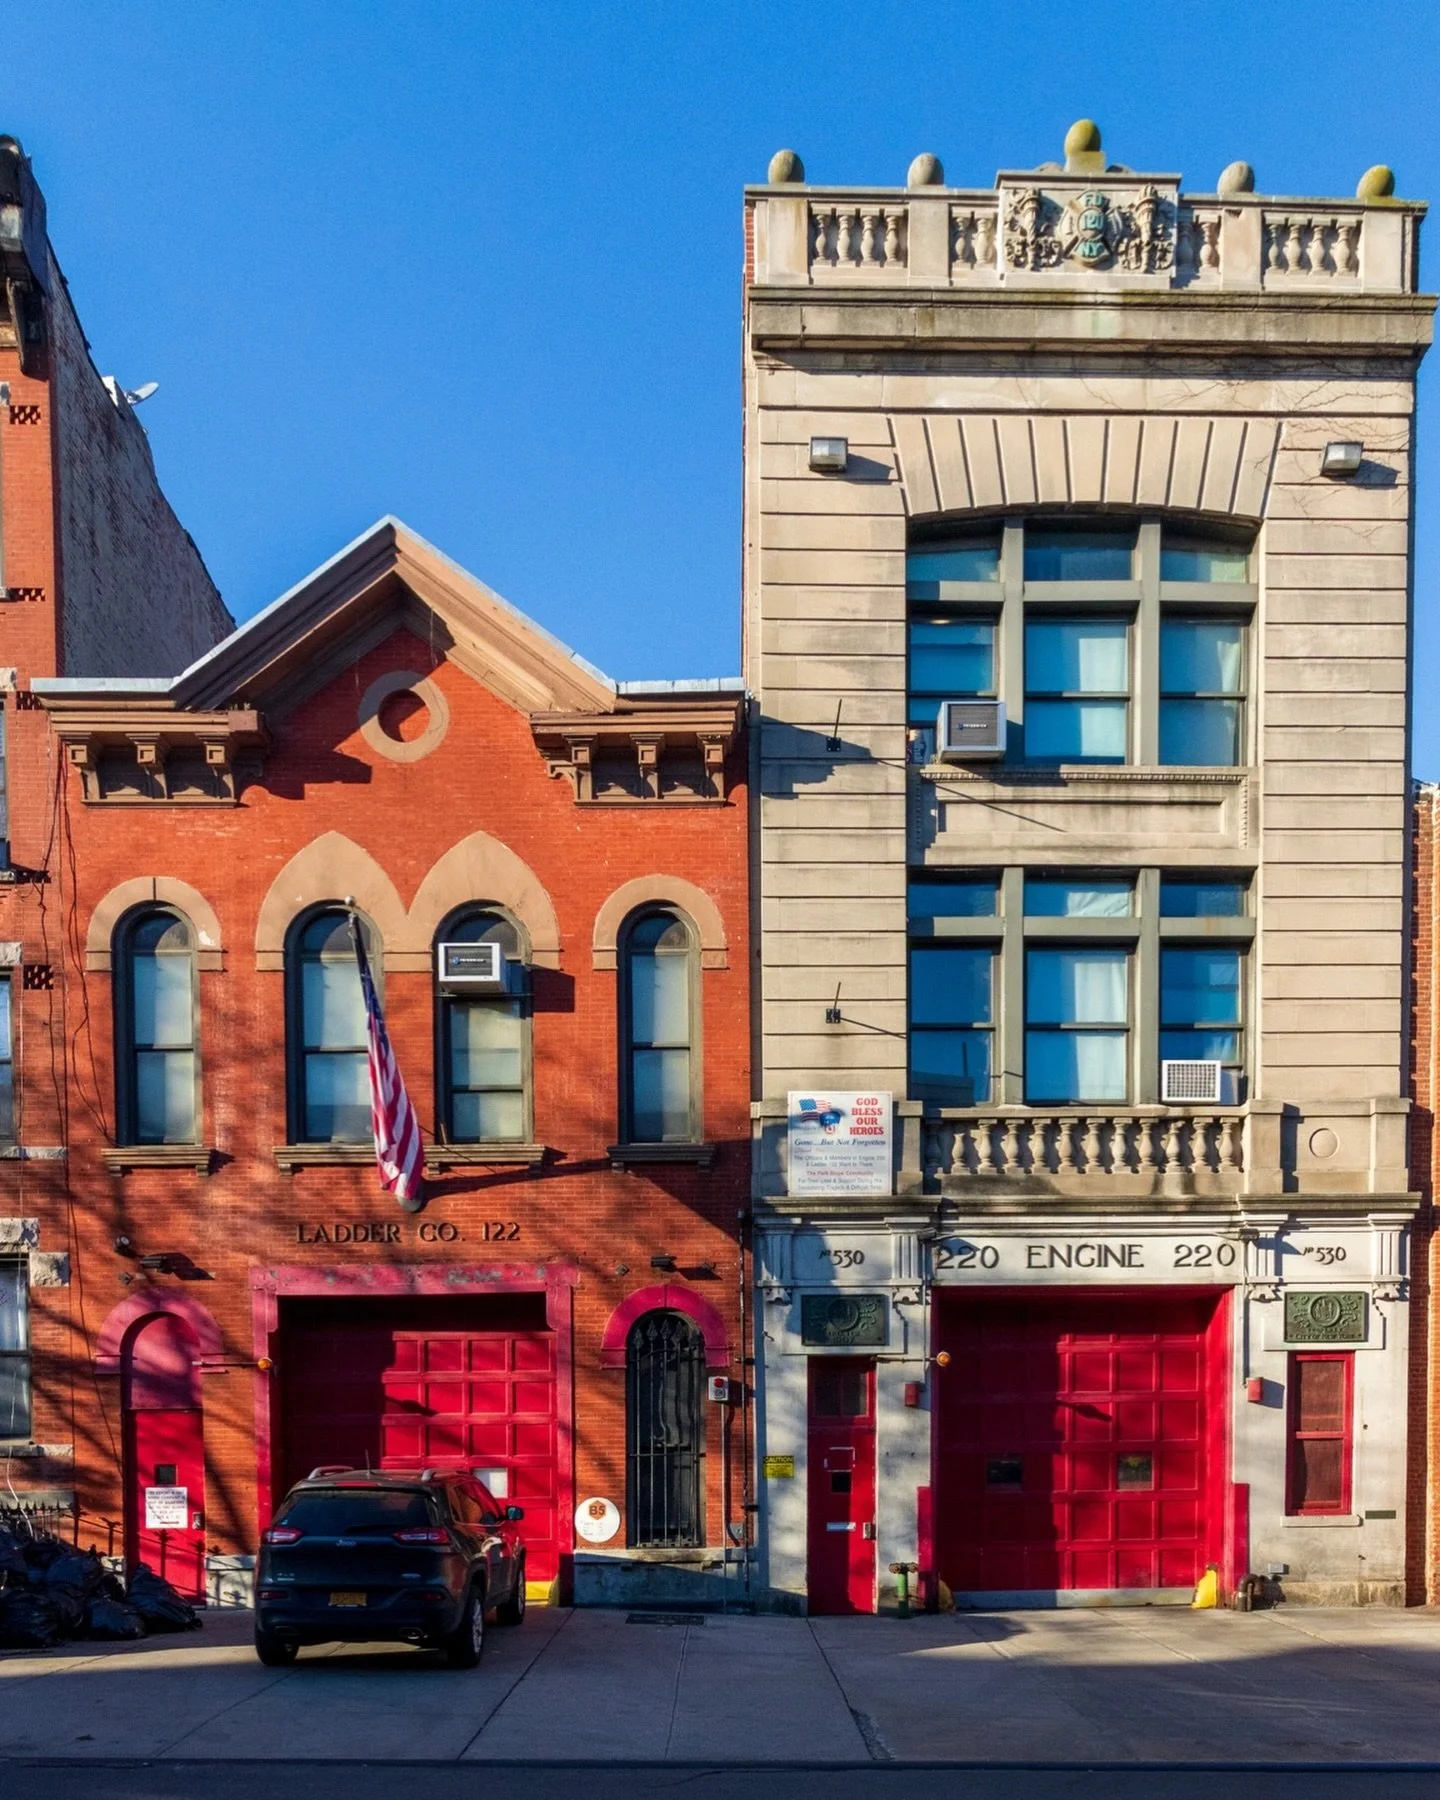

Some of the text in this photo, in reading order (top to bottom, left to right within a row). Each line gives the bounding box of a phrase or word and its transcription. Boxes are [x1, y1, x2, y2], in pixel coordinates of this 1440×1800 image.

[856, 1097, 878, 1106] GOD
[851, 1107, 883, 1116] BLESS
[856, 1117, 878, 1125] OUR
[849, 1126, 885, 1136] HEROES
[837, 1138, 850, 1146] Not
[852, 1138, 886, 1147] Forgotten
[296, 1222, 521, 1244] LADDER CO. 122
[831, 1250, 866, 1269] 530
[936, 1243, 1236, 1269] 220 ENGINE 220
[1314, 1246, 1347, 1266] 530
[589, 1504, 605, 1516] B5
